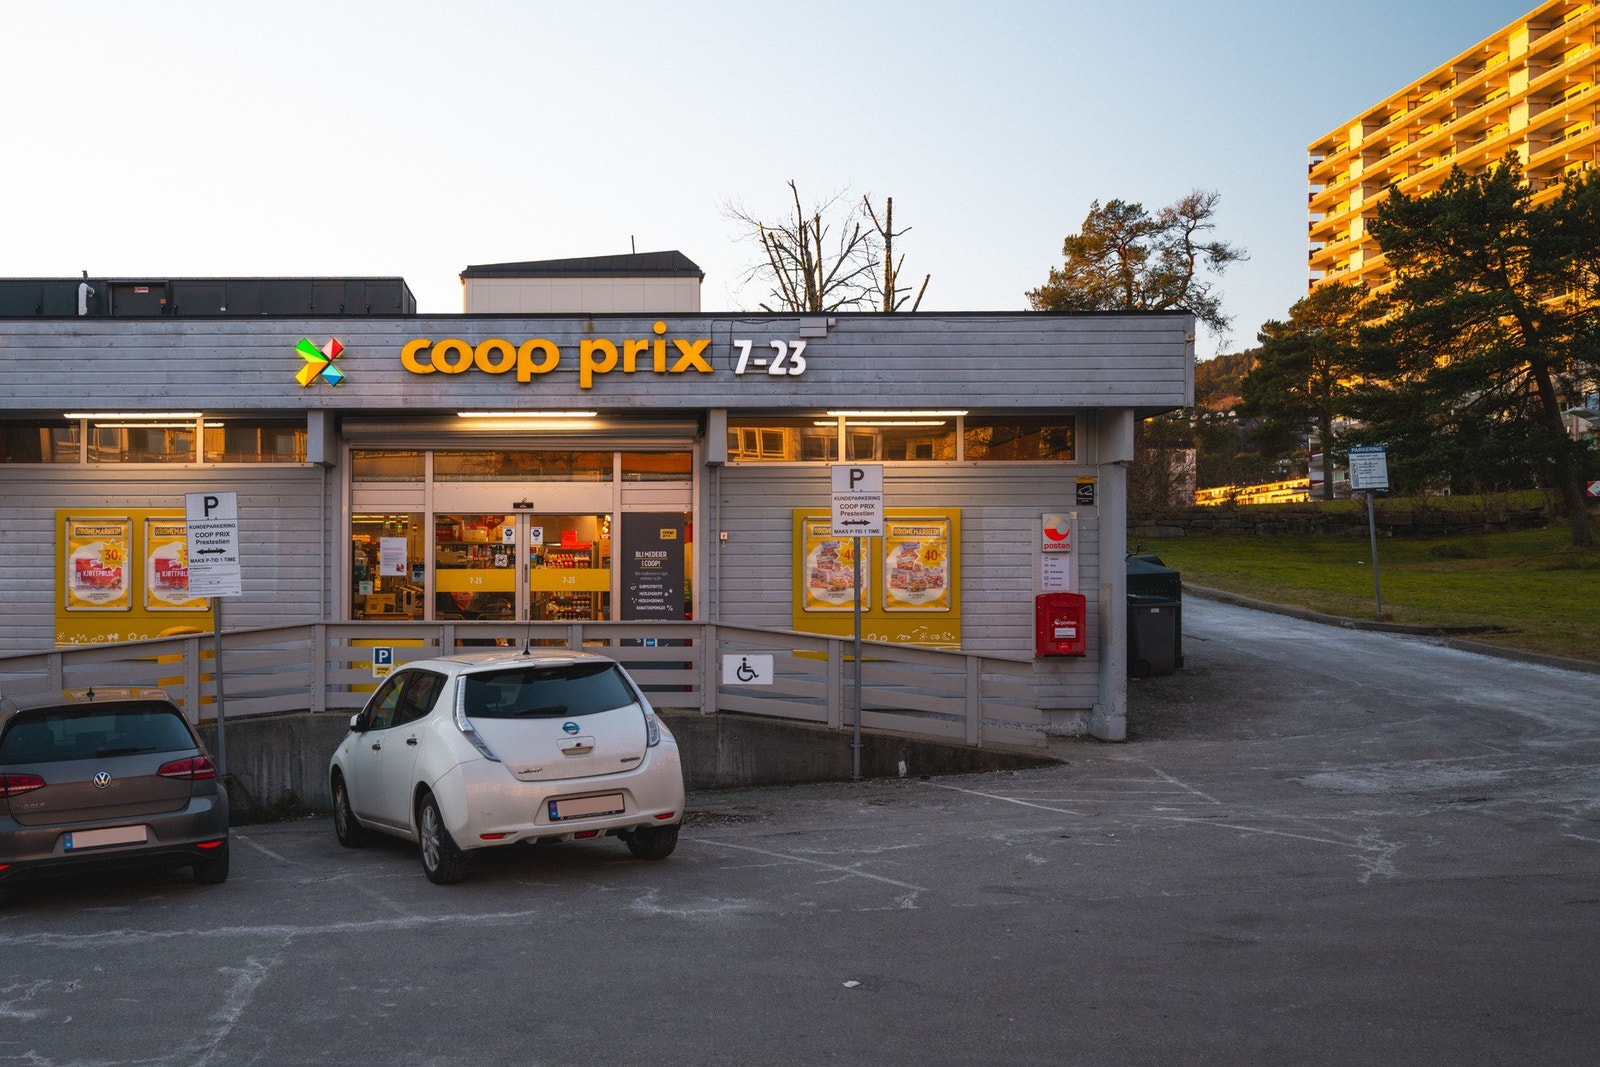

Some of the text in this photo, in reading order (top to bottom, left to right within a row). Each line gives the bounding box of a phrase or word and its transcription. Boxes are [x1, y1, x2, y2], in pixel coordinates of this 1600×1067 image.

[401, 320, 714, 389] coop prix
[733, 339, 807, 375] 7-23
[850, 468, 865, 489] P
[204, 496, 219, 517] P
[1044, 542, 1071, 550] posten
[562, 576, 575, 584] 7-23
[379, 649, 389, 663] P
